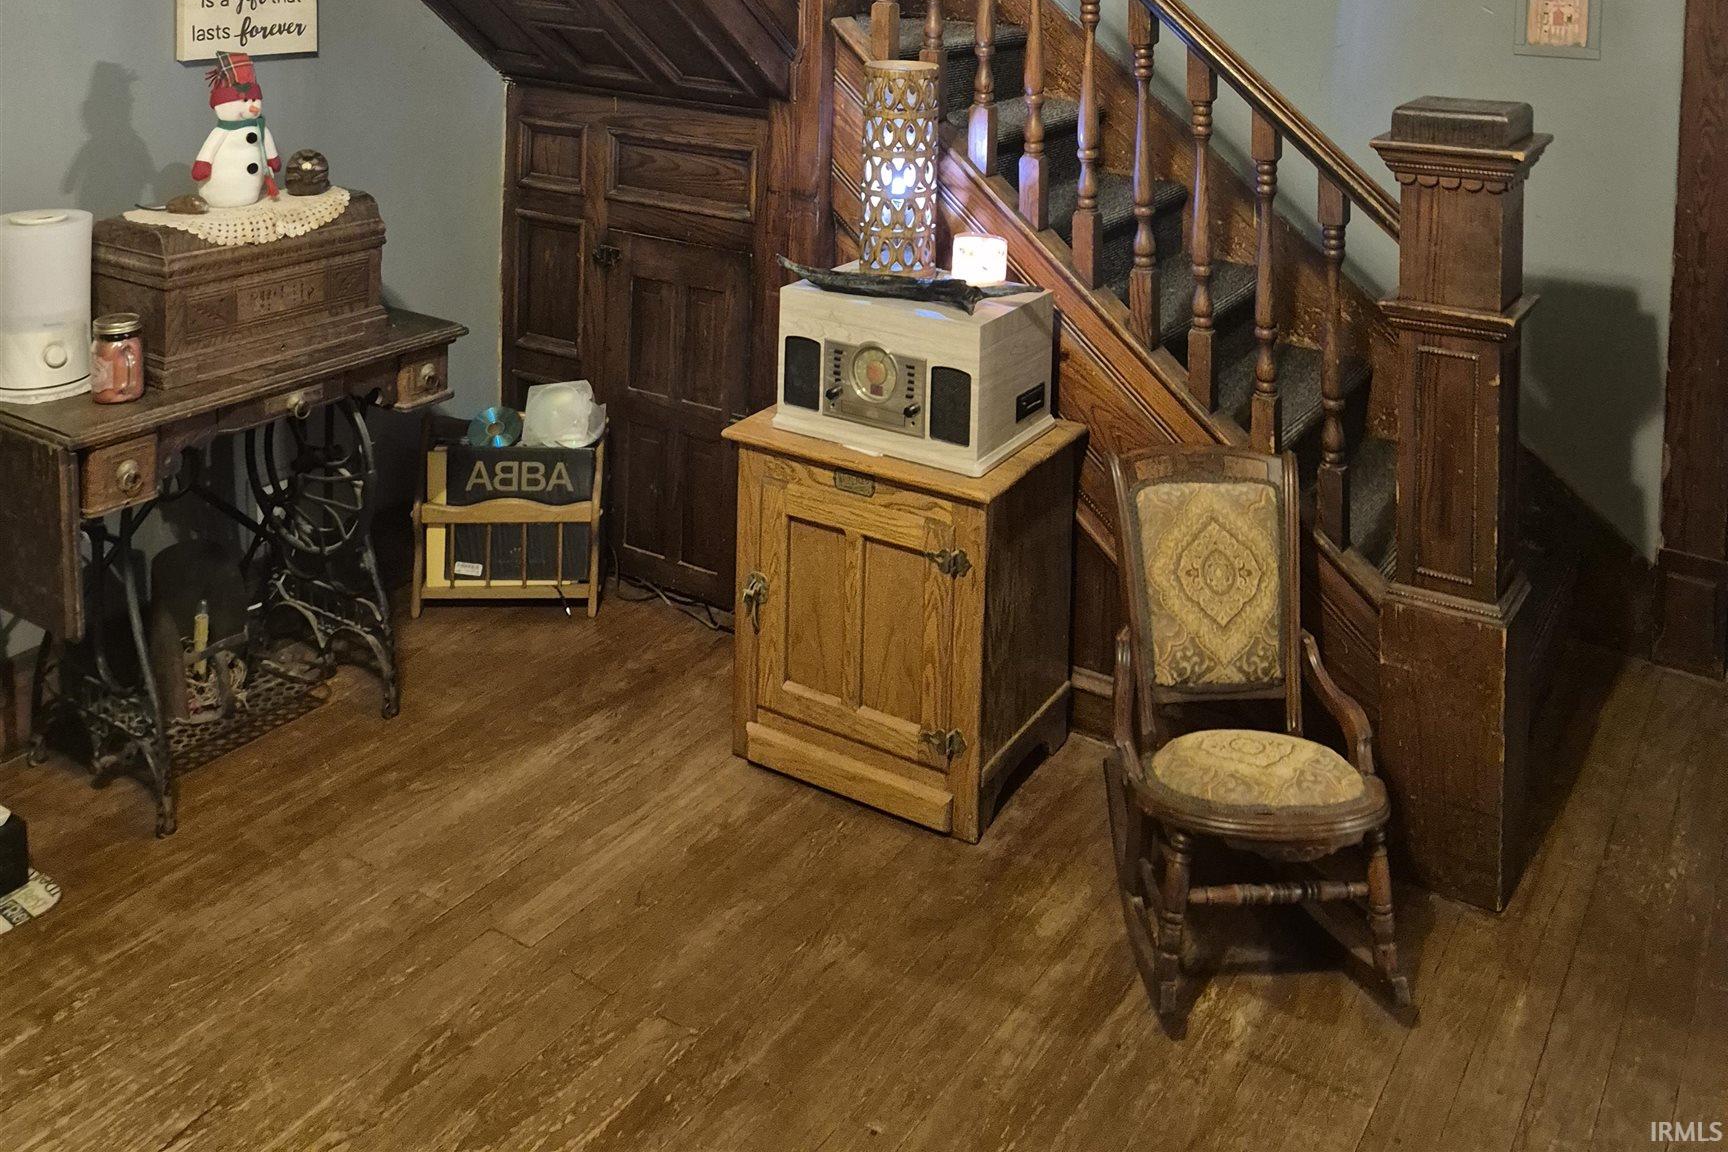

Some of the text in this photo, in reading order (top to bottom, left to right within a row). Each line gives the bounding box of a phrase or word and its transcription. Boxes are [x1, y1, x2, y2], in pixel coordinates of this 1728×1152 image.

[192, 16, 307, 47] lasts forever
[465, 460, 574, 493] ABBA
